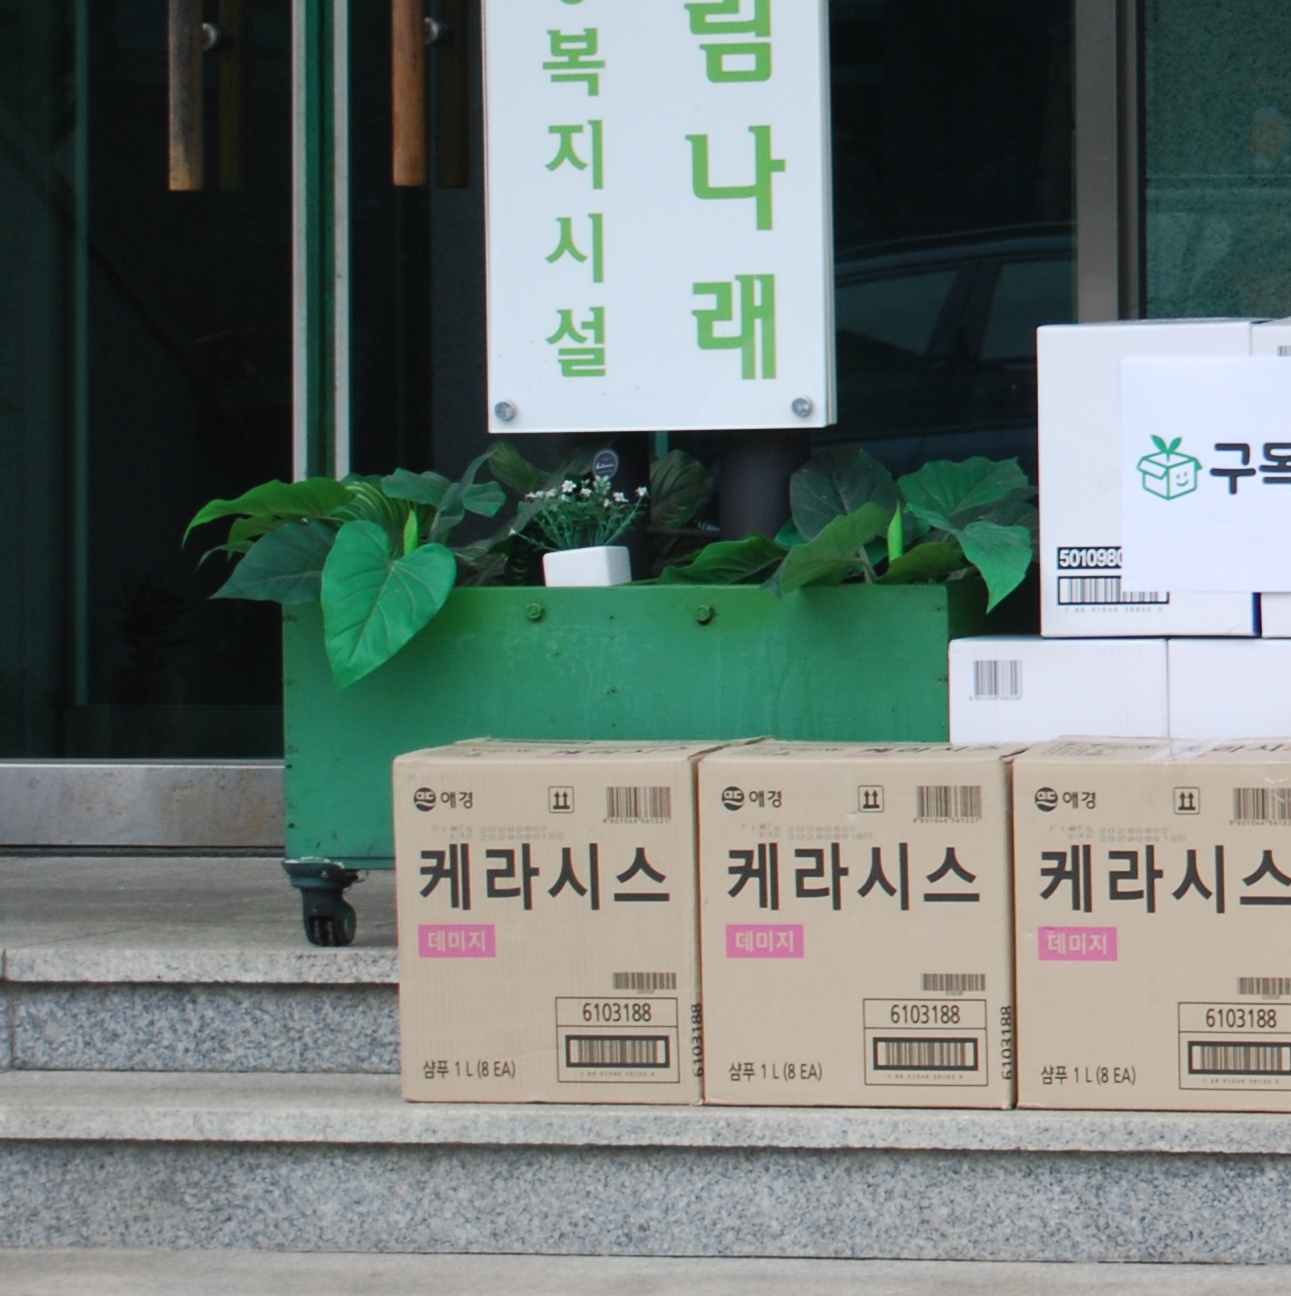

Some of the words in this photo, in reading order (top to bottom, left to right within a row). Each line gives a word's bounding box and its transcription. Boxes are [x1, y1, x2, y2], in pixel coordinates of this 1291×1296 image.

[440, 791, 474, 809] 애경
[748, 789, 783, 808] 애경
[1062, 791, 1097, 809] 애경
[419, 842, 670, 911] 케라시스
[727, 842, 981, 911] 케라시스
[427, 930, 487, 952] 데미지
[735, 930, 795, 953] 데미지
[1048, 932, 1108, 955] 데미지
[583, 1003, 652, 1023] 6103188
[890, 1004, 960, 1024] 6103188
[1206, 1008, 1277, 1028] 6103188
[422, 1060, 450, 1080] 샴푸
[455, 1061, 461, 1077] 1
[466, 1061, 474, 1077] L
[494, 1060, 516, 1079] EA)
[728, 1062, 756, 1082] 샴푸
[761, 1064, 766, 1080] 1
[772, 1064, 780, 1080] L
[801, 1062, 823, 1082] EA)
[1040, 1066, 1068, 1085] 샴푸
[1074, 1067, 1079, 1082] 1
[1085, 1067, 1093, 1082] L
[1113, 1066, 1136, 1085] EA)
